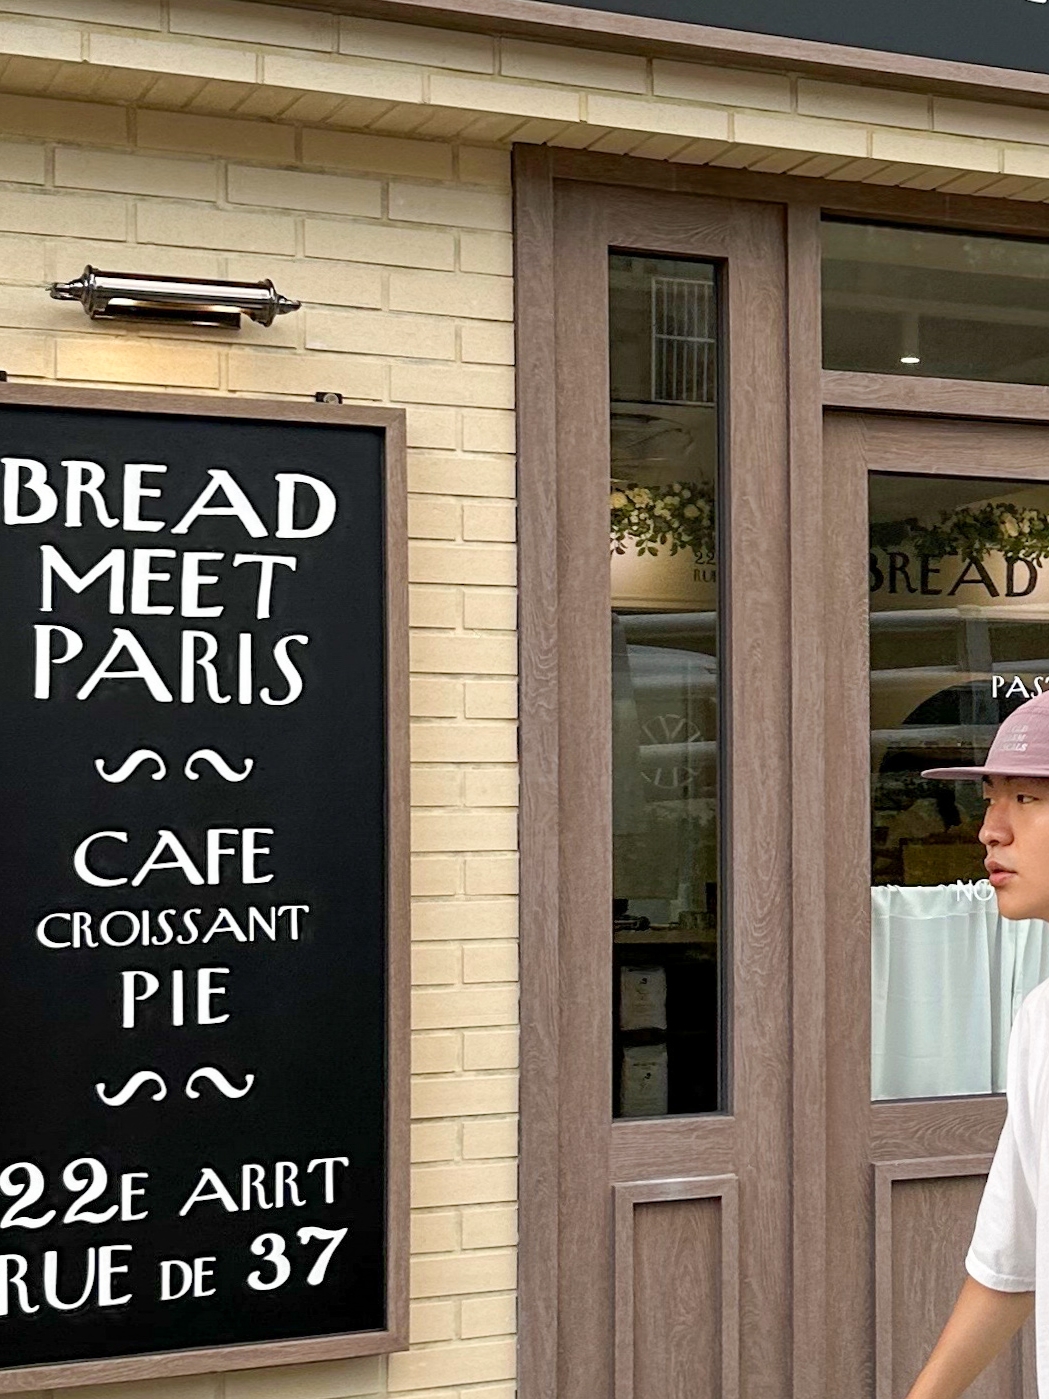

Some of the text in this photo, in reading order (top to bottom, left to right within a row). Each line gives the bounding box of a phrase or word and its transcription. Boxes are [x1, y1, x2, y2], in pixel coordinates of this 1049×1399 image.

[1, 457, 337, 539] BREAD
[40, 544, 297, 620] MEET
[33, 624, 309, 706] PARIS
[74, 828, 274, 887] CAFE
[36, 905, 309, 948] CROISSANT
[120, 967, 230, 1028] PIE
[179, 1156, 349, 1217] ARRT
[0, 1226, 349, 1315] RUE DE 37
